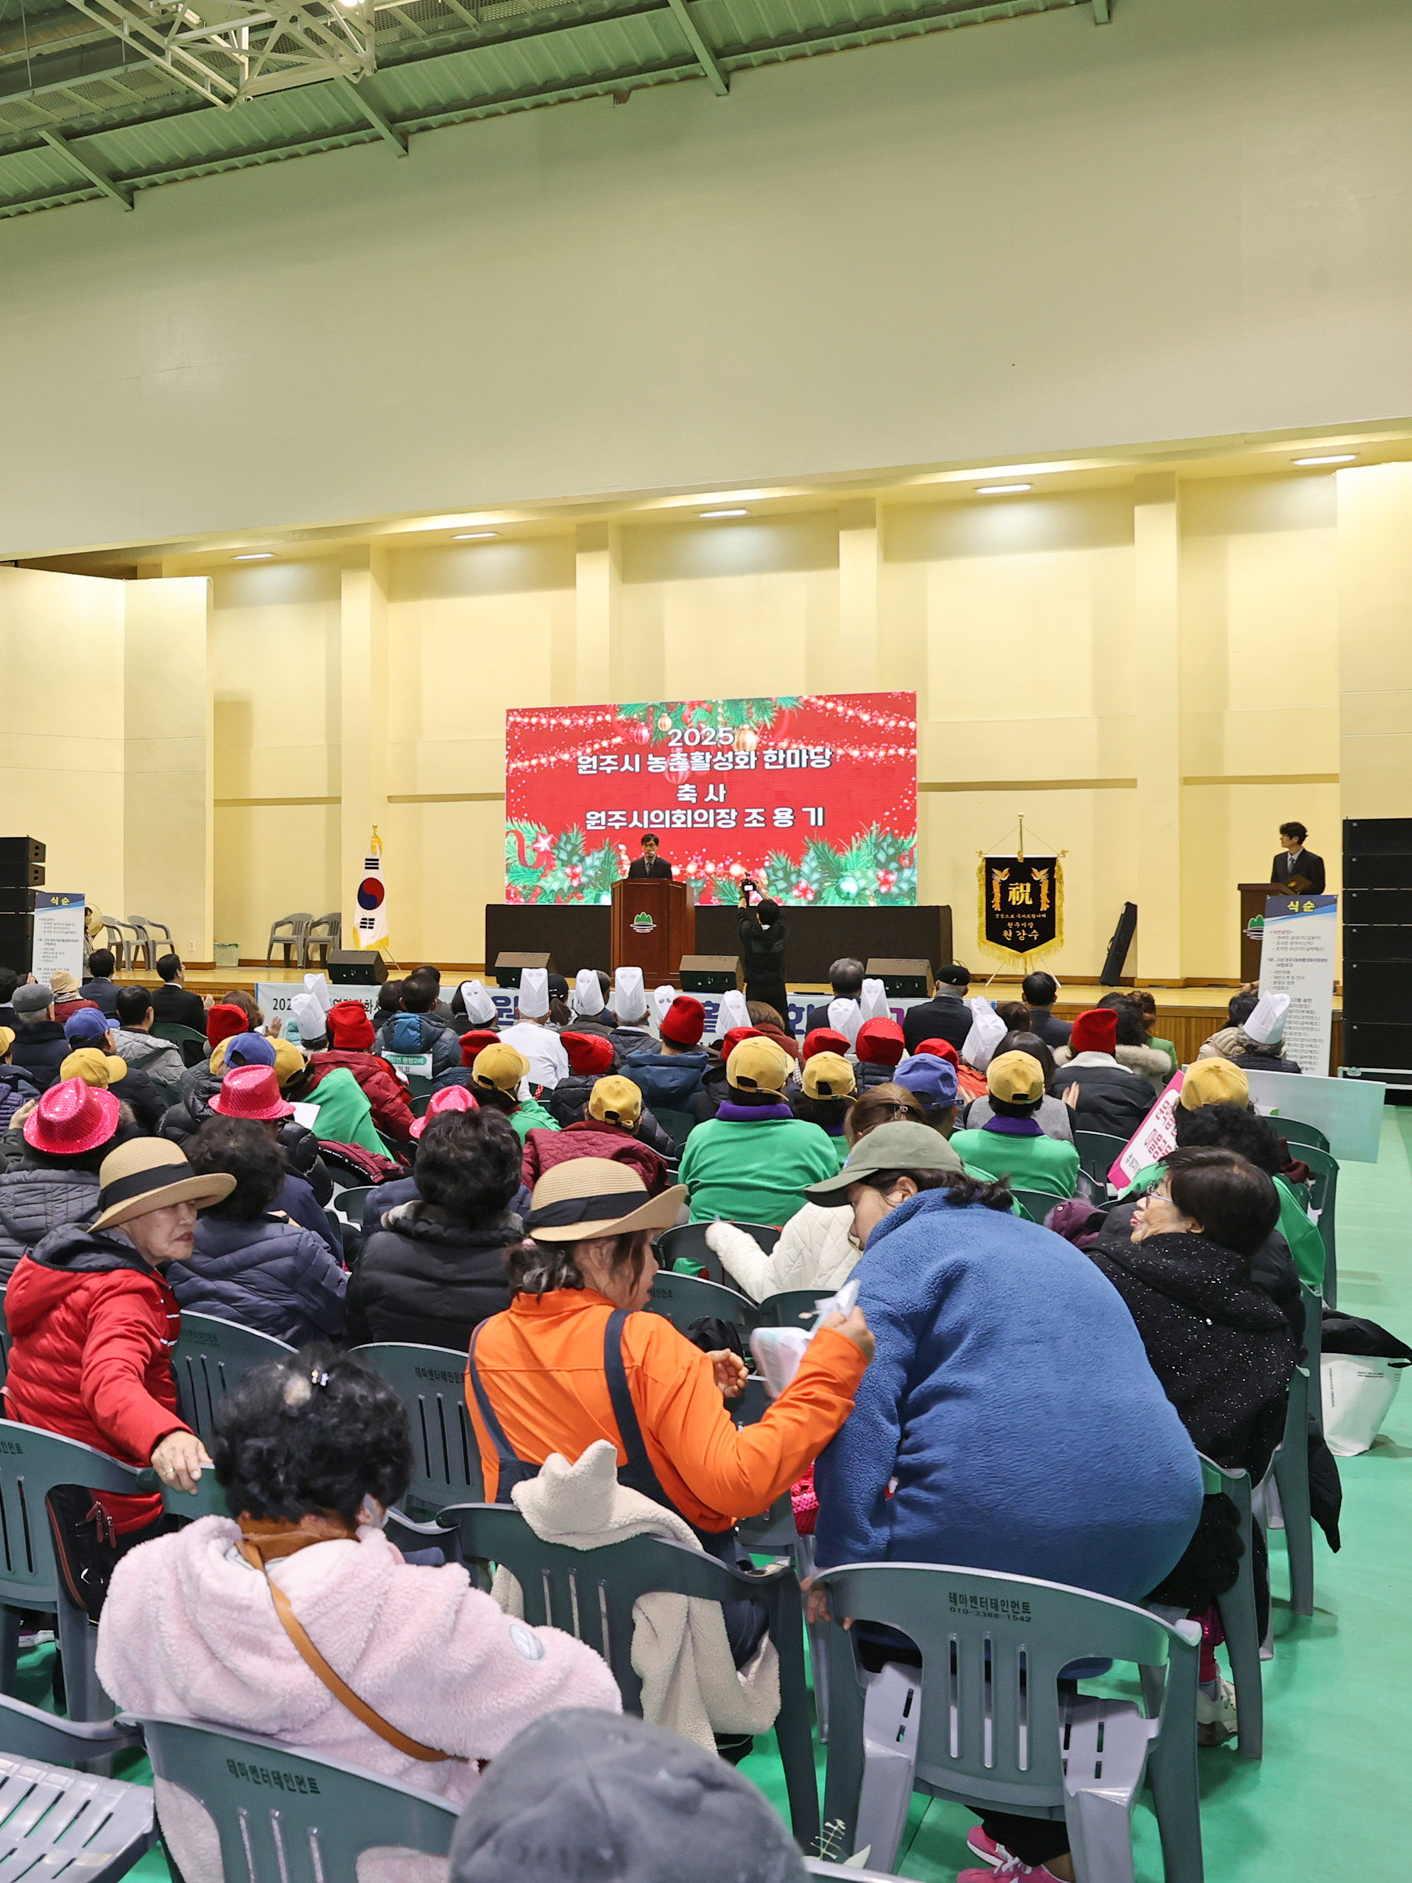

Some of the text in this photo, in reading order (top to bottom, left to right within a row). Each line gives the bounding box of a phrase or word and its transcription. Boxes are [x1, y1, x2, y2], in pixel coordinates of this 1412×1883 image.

[667, 727, 735, 747] 2025
[577, 748, 833, 774] 원주시 농촌활성화 한마당
[585, 808, 738, 830] 원주시의회의장
[1008, 882, 1033, 905] 祝
[273, 998, 292, 1010] 202
